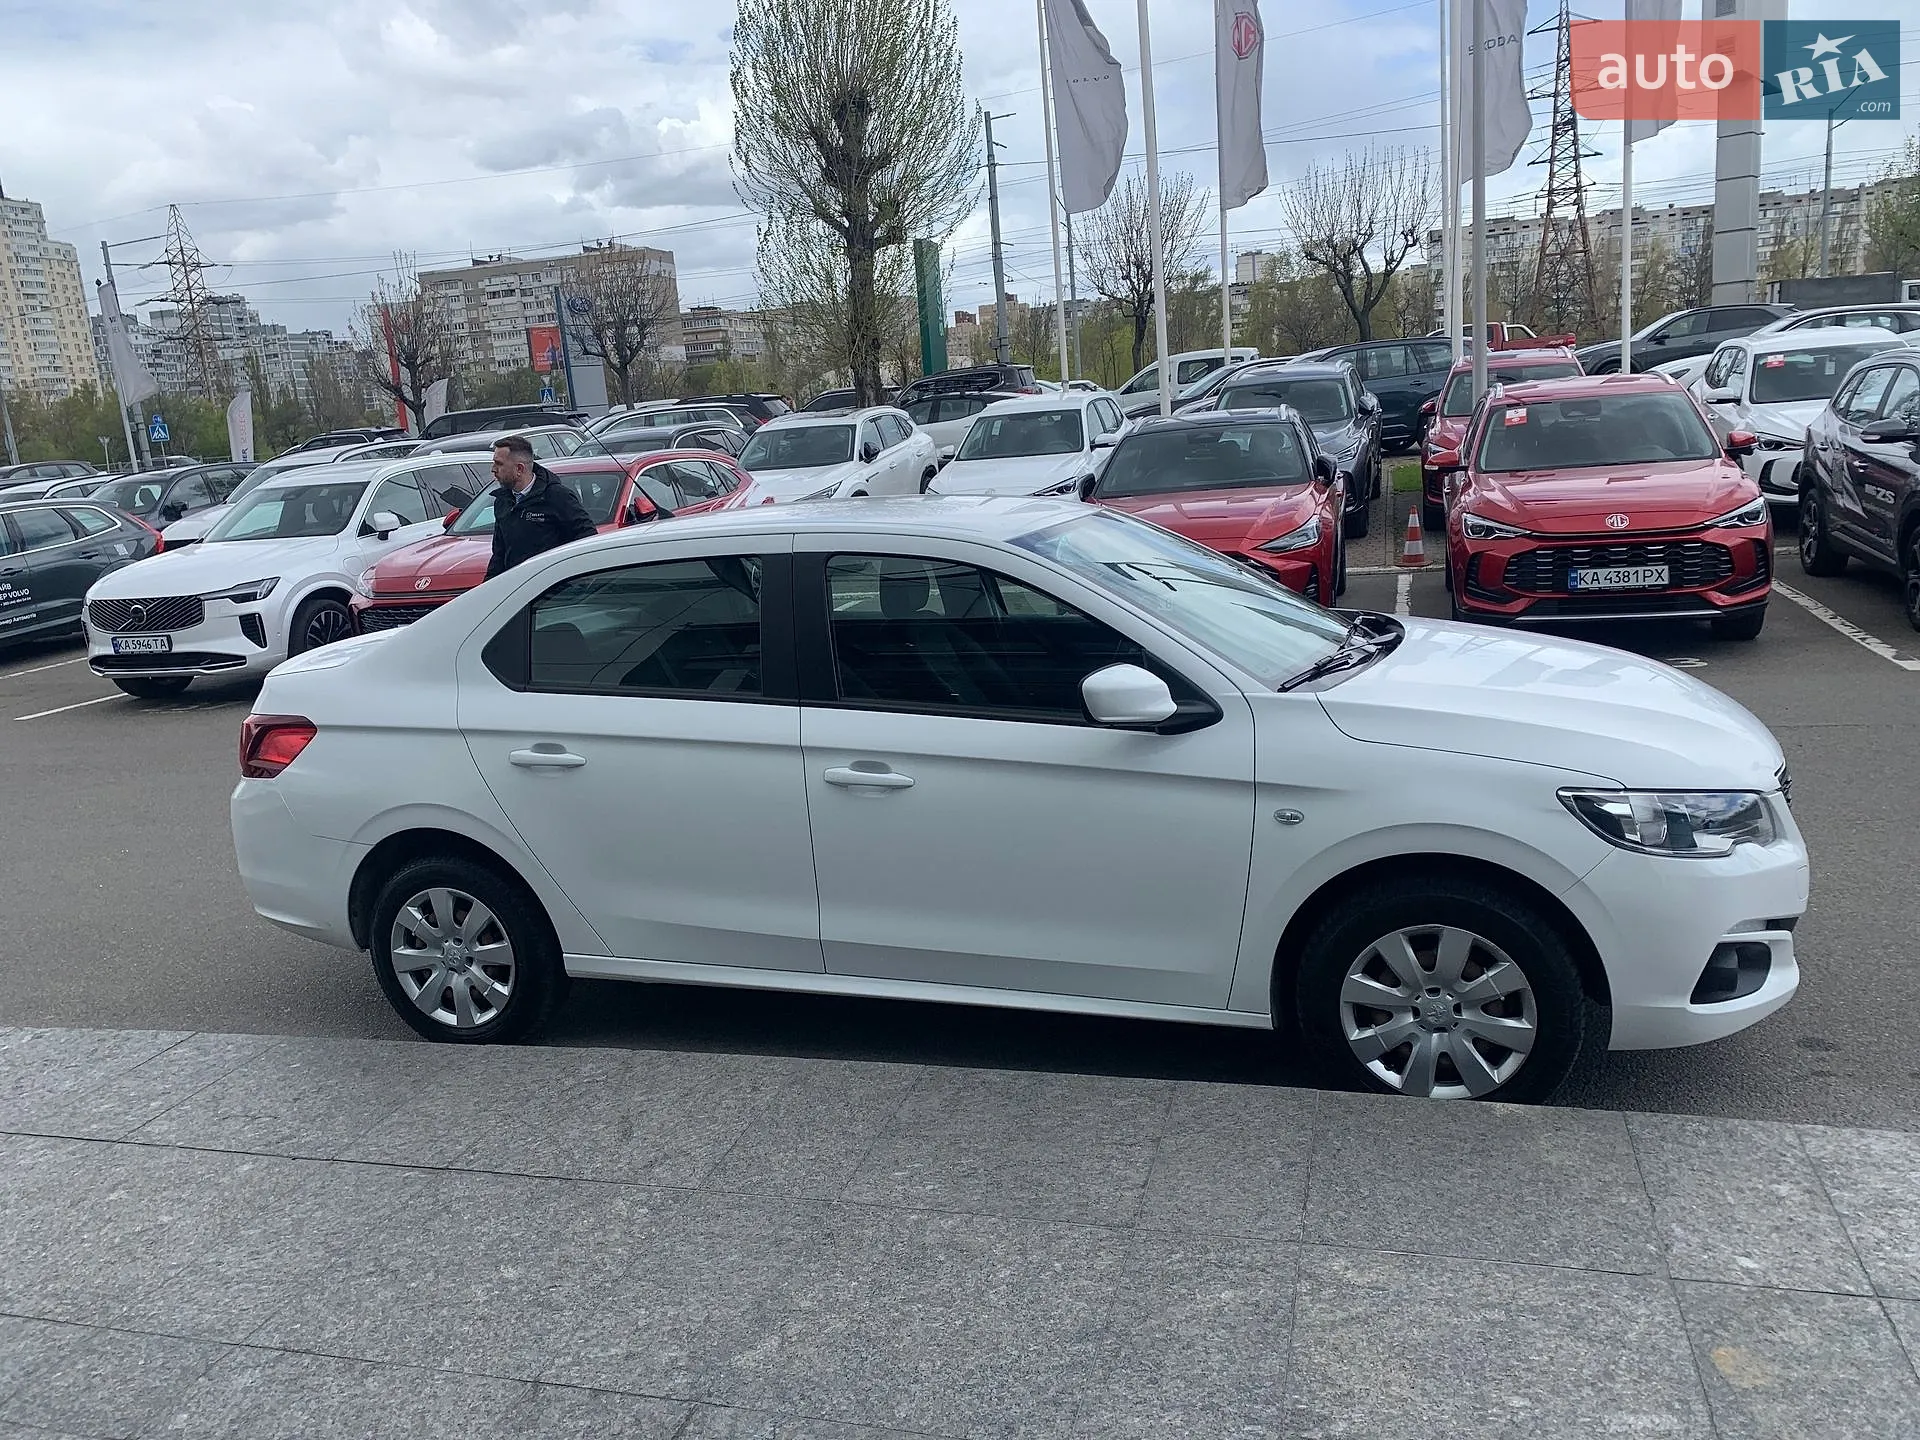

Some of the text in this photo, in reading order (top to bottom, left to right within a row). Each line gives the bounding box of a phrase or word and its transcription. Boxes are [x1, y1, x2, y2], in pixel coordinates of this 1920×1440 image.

[1606, 514, 1629, 528] MG
[1579, 568, 1666, 585] KA 4381 PX
[8, 588, 30, 598] VOLVO
[118, 639, 167, 650] KA 5946 TA
